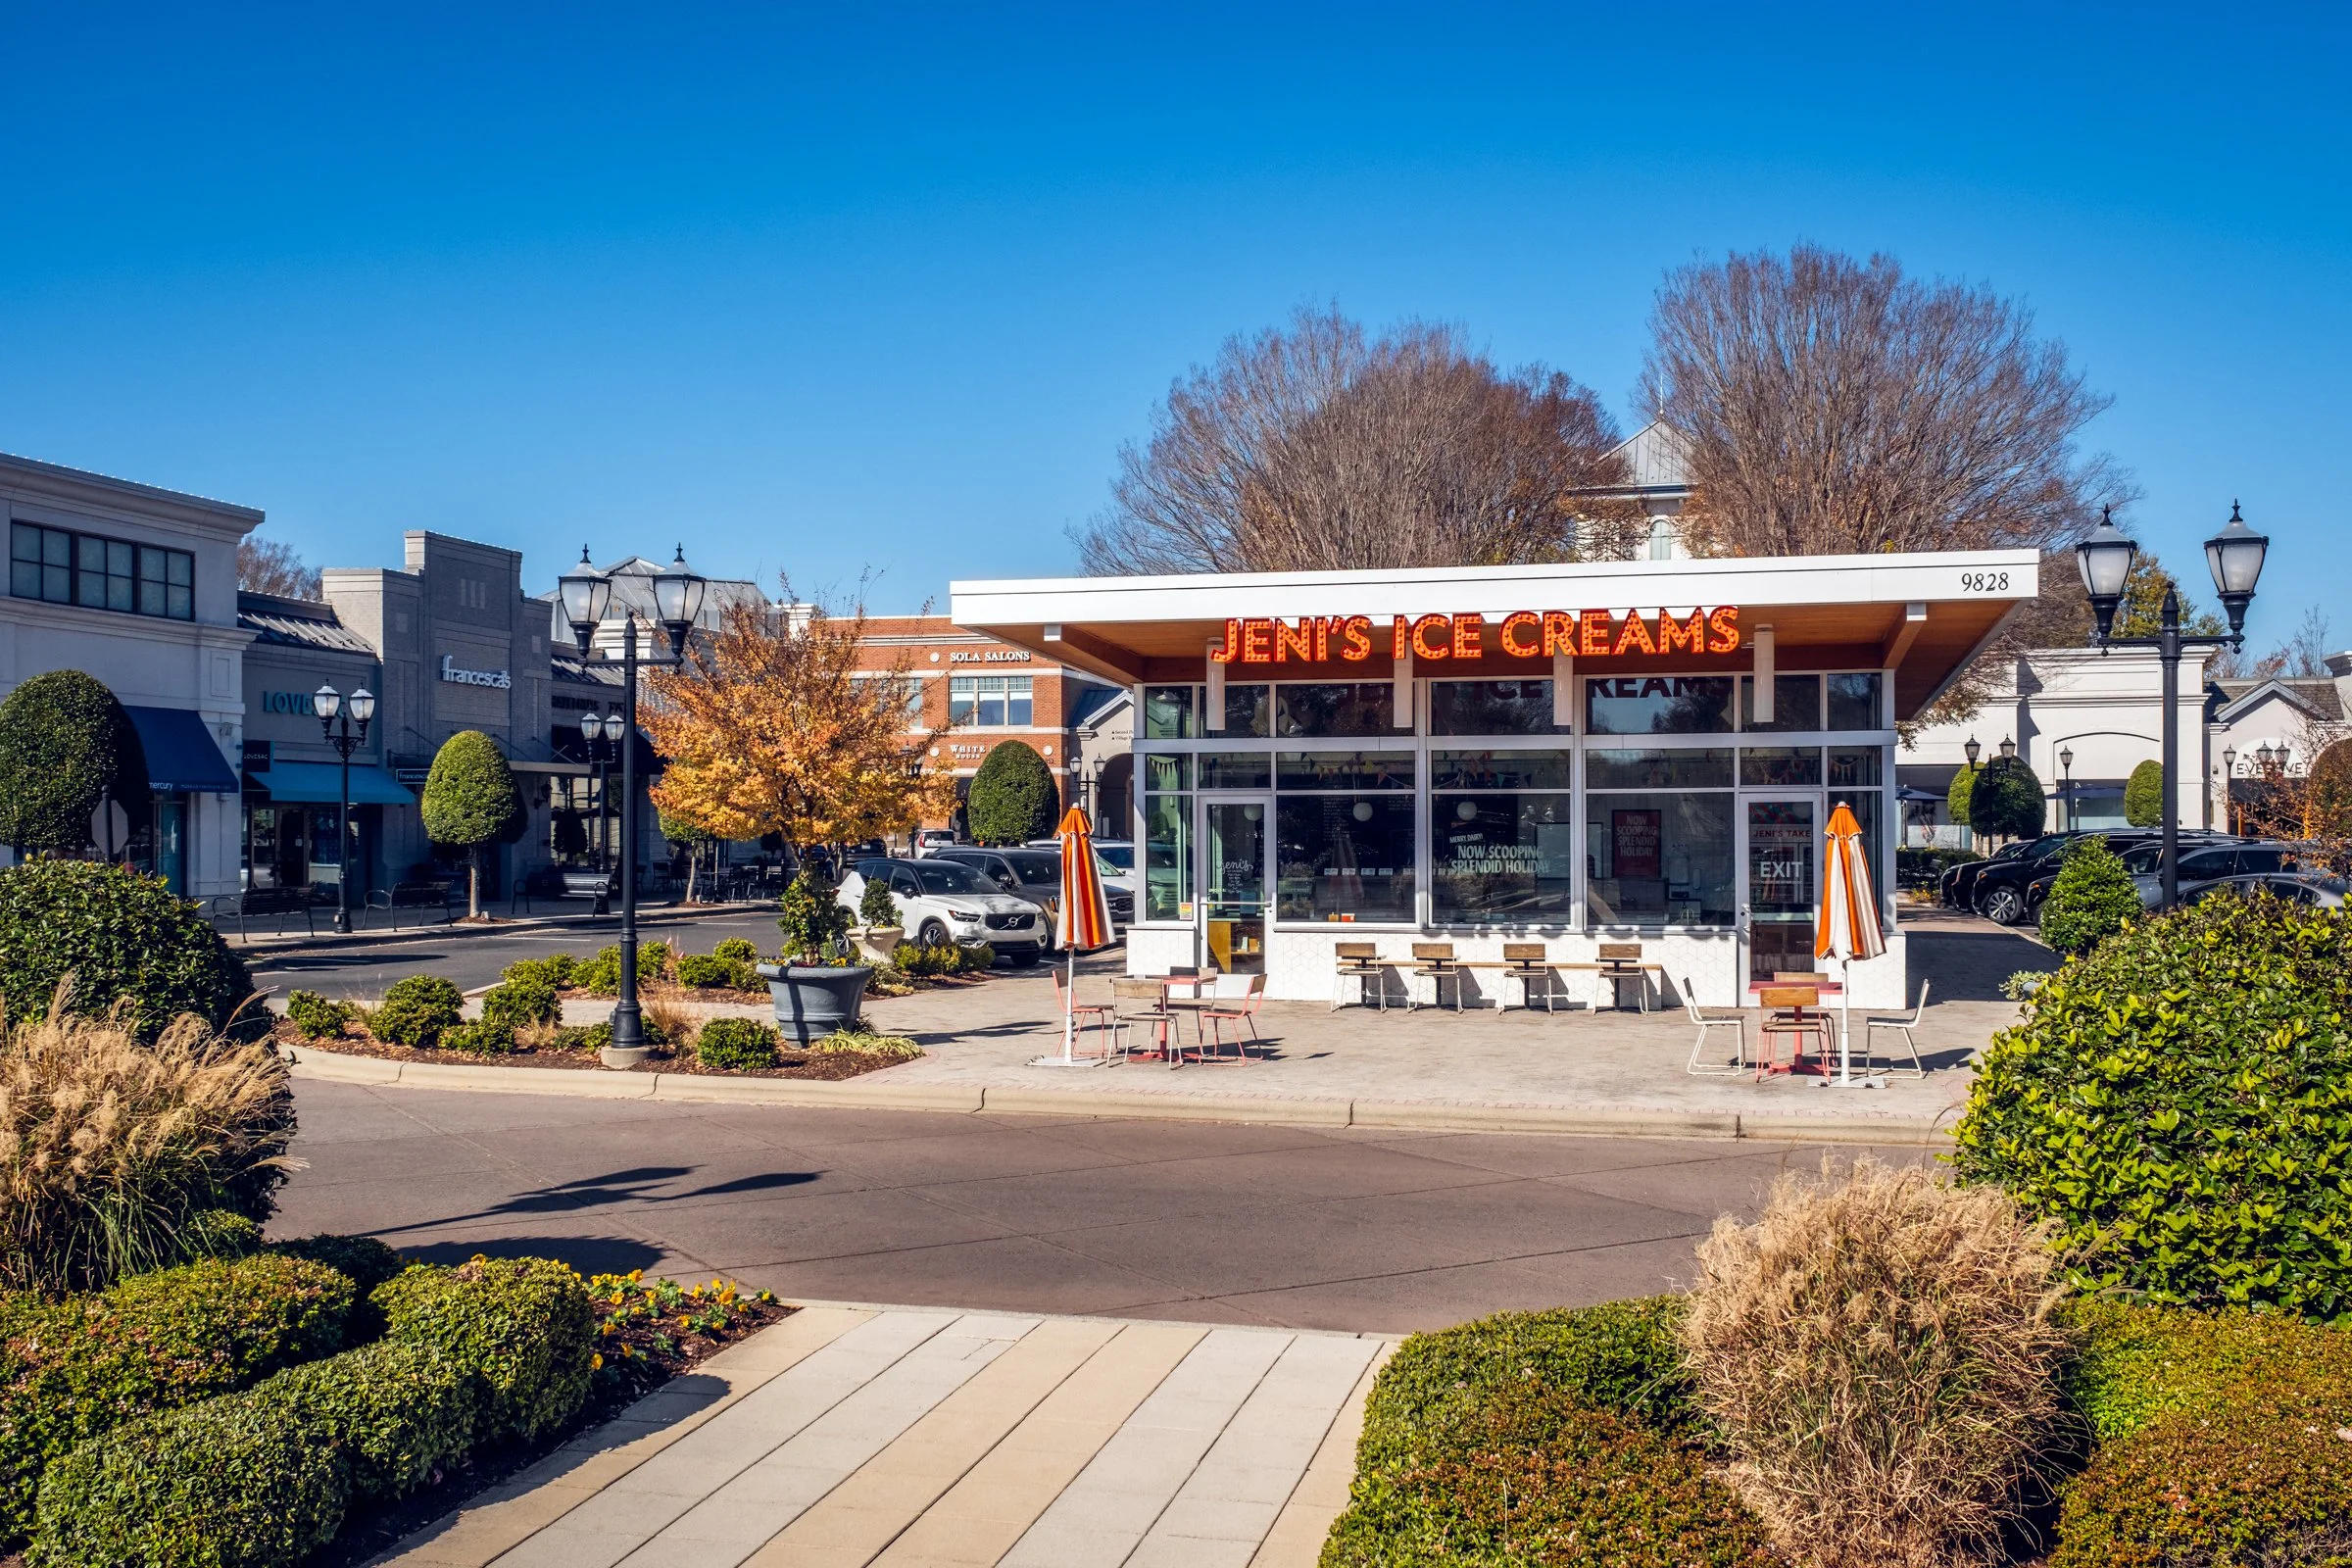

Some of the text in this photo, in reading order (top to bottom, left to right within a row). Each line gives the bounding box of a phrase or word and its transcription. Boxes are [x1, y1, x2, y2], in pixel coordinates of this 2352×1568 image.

[1961, 572, 2009, 592] 9828
[1210, 605, 1740, 663] JENI'S ICE CREAMS
[949, 651, 1032, 662] SOLA SALONS
[950, 745, 987, 754] WHITE
[1626, 814, 1648, 826] NOW
[1616, 825, 1658, 837] SCOOPING
[1787, 829, 1811, 838] TAKE
[1617, 836, 1656, 847] SPLENDID
[1457, 845, 1544, 859] NOW SCOOPING
[1620, 846, 1655, 858] HOLIDAY
[1450, 859, 1502, 874] SPLENDID
[1505, 859, 1550, 873] HOLIDAY
[1760, 861, 1804, 878] EXIT
